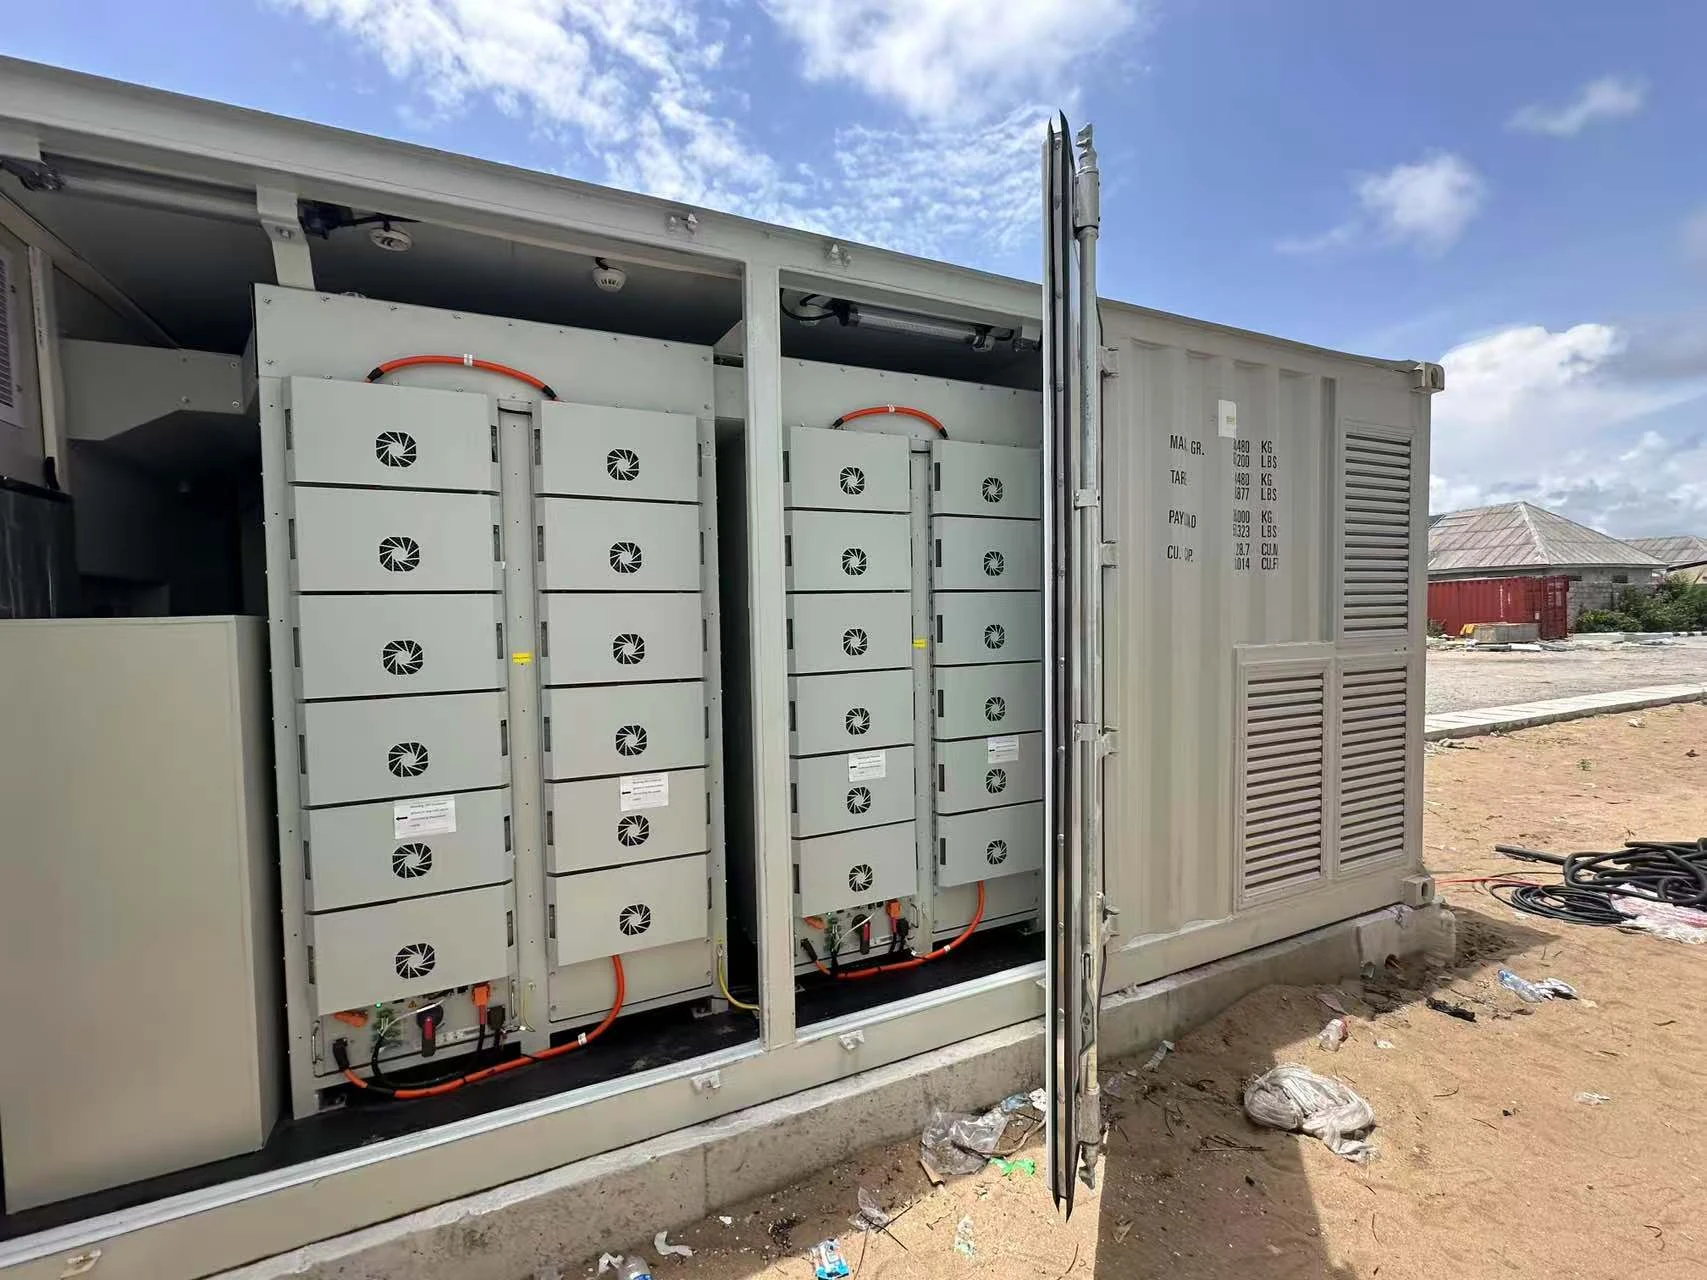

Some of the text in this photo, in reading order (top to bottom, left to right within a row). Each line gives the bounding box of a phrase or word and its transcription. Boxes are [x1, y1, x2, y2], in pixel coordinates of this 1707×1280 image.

[1261, 440, 1273, 454] KG
[1261, 455, 1278, 469] LBS
[1261, 473, 1272, 487] KG
[1261, 487, 1277, 501] LBS
[1261, 510, 1273, 524] KG
[1261, 525, 1277, 538] LBS
